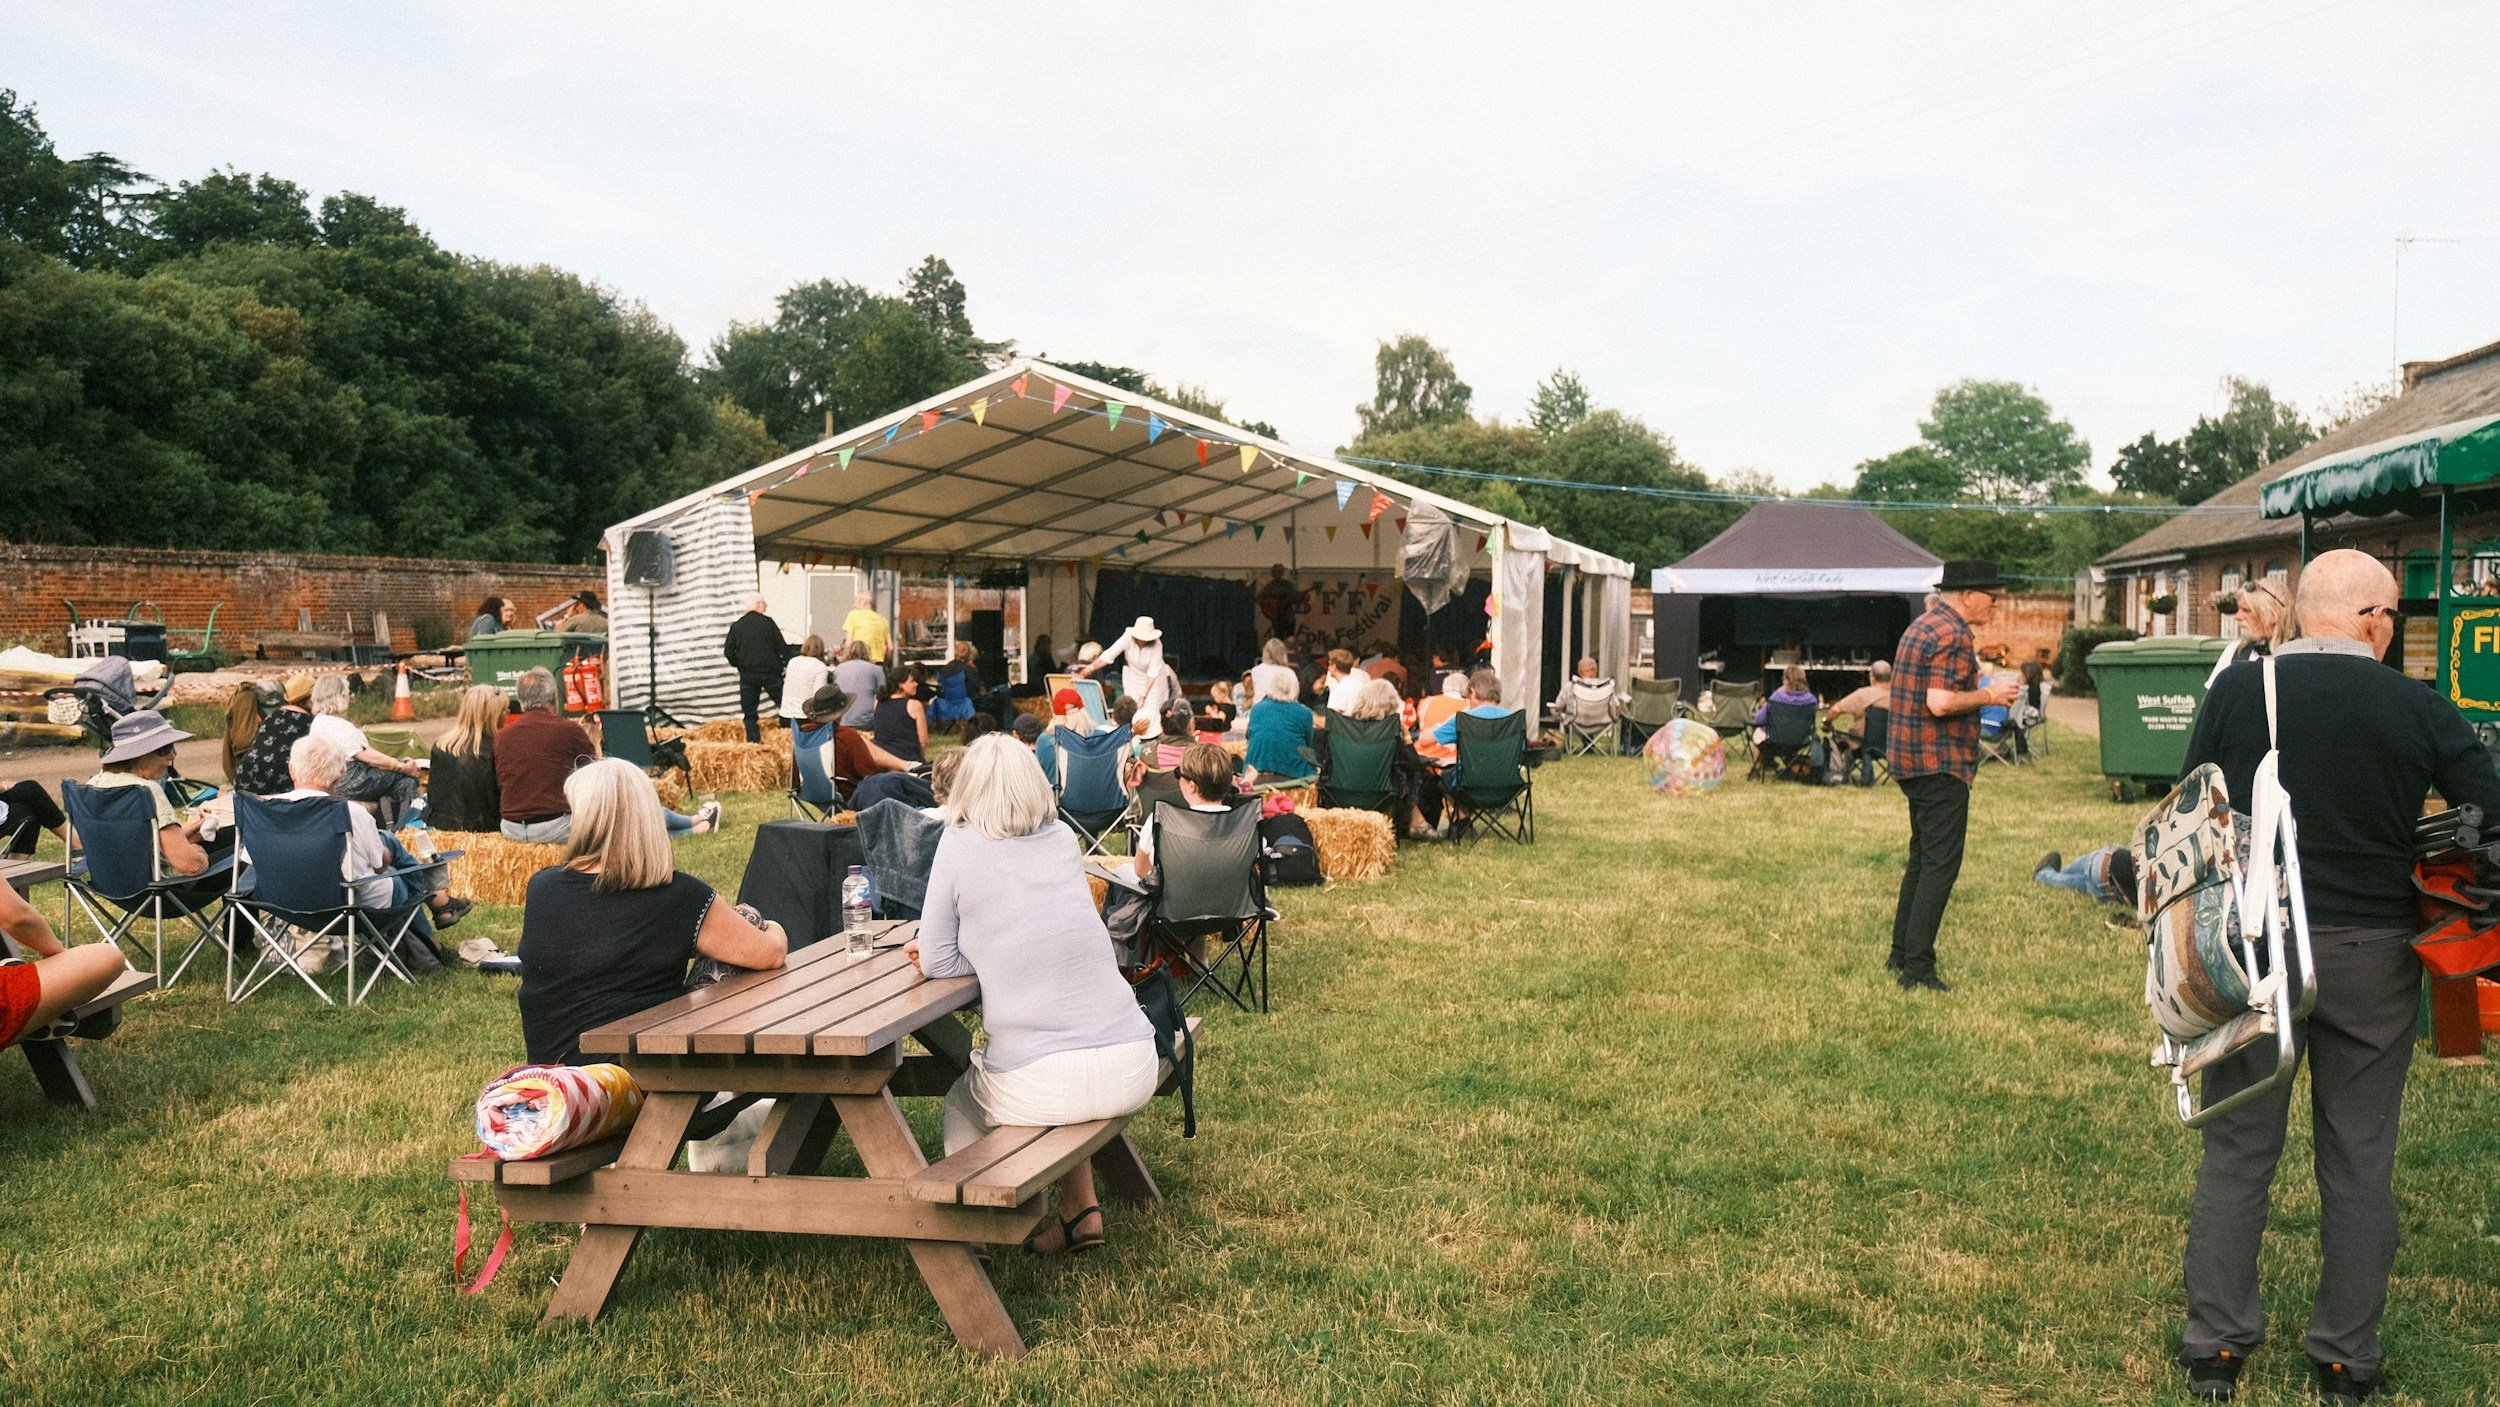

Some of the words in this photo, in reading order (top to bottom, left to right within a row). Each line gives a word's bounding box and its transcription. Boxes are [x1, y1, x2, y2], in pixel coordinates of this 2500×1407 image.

[1335, 594, 1393, 643] Festival
[2137, 694, 2161, 705] West
[2162, 694, 2195, 706] Suffolk
